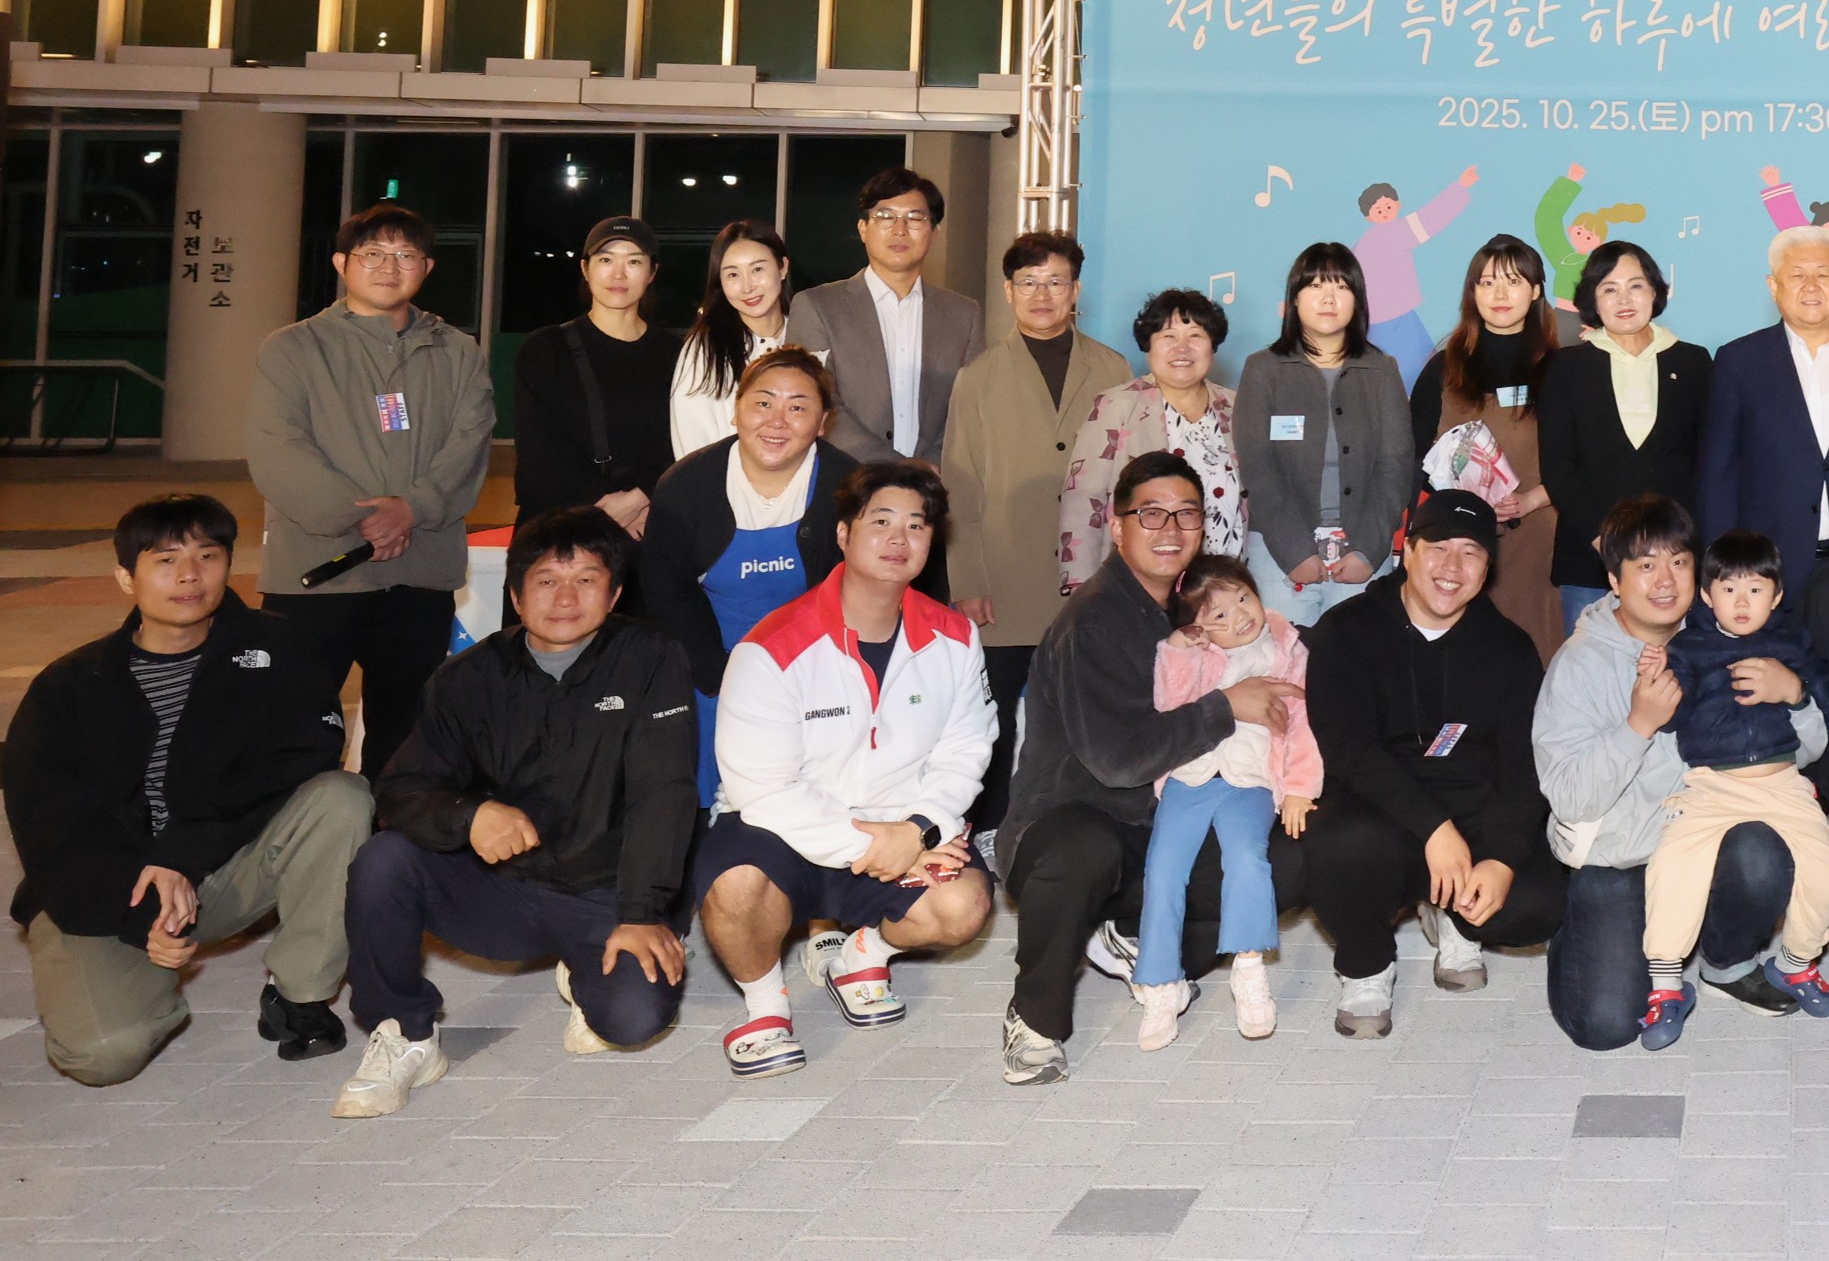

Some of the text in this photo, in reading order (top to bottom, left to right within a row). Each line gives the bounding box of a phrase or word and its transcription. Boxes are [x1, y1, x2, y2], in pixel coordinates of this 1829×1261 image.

[1438, 96, 1528, 129] 2025.
[1538, 99, 1579, 130] 10.
[1589, 100, 1692, 133] 25.(토)
[1701, 108, 1754, 139] pm
[182, 210, 202, 283] 자전거
[209, 237, 234, 307] 보관소
[740, 555, 795, 579] picnic
[805, 706, 845, 721] GANGWON
